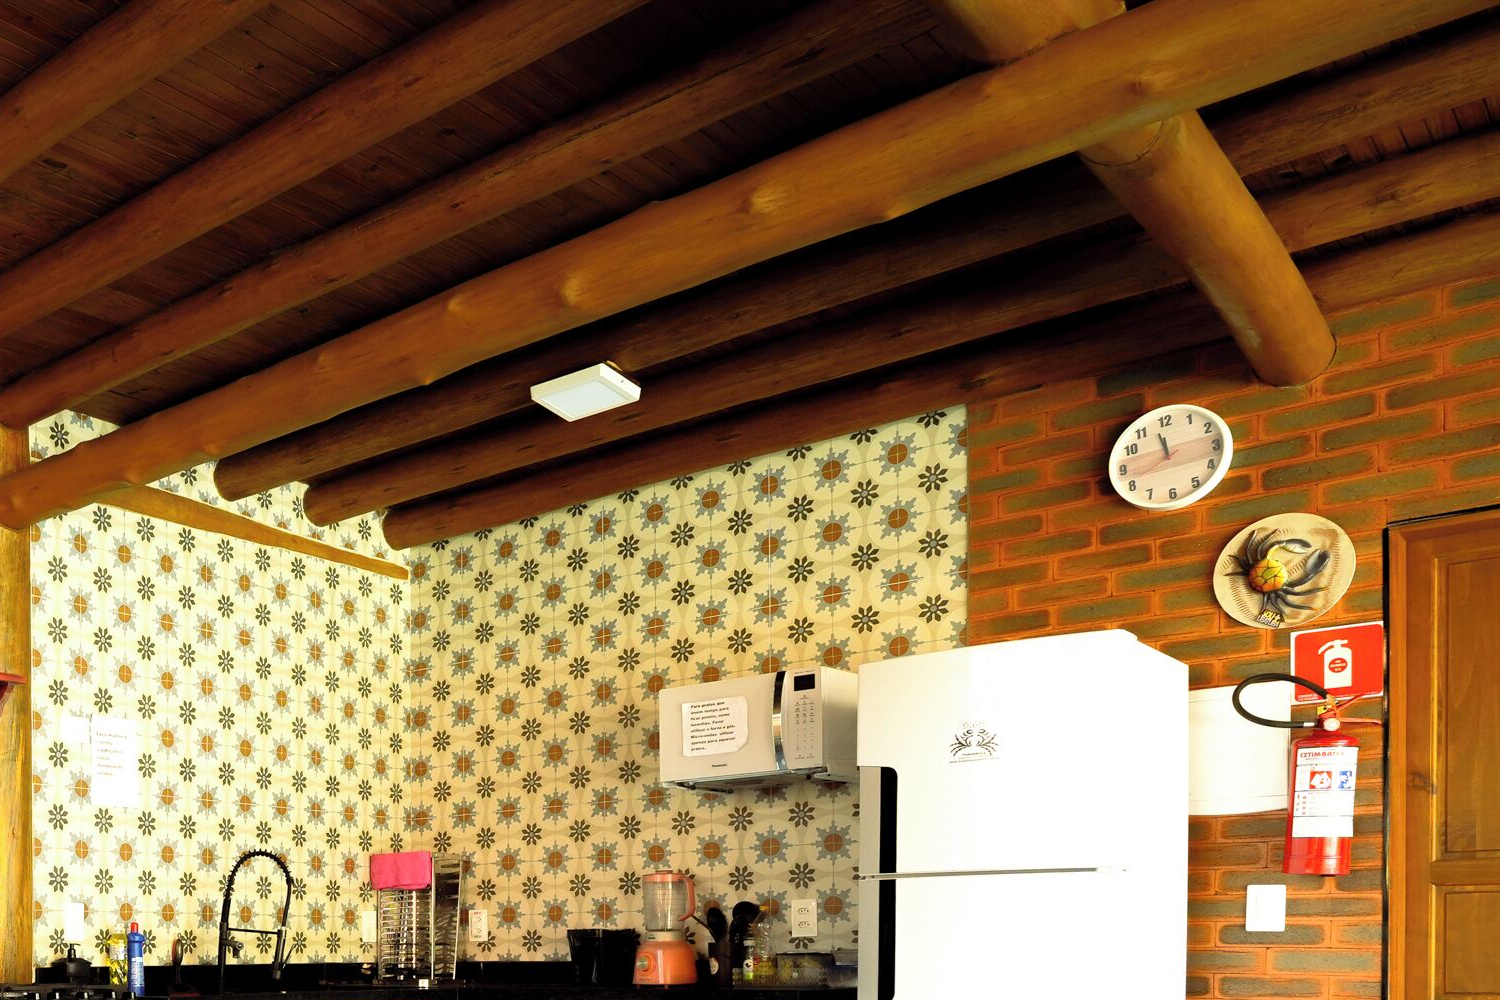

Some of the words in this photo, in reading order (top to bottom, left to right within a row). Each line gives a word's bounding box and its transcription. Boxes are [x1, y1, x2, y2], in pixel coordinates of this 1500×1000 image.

[1158, 414, 1172, 428] 12
[1186, 413, 1193, 425] 1
[1135, 426, 1147, 440] 11
[1204, 421, 1213, 434] 2
[1124, 443, 1139, 456] 10
[1211, 439, 1220, 451] 3
[1119, 464, 1128, 476] 9
[1207, 458, 1216, 470] 4
[1128, 480, 1137, 492] 8
[1191, 476, 1200, 489] 5
[1146, 488, 1154, 500] 7
[1168, 488, 1178, 500] 6
